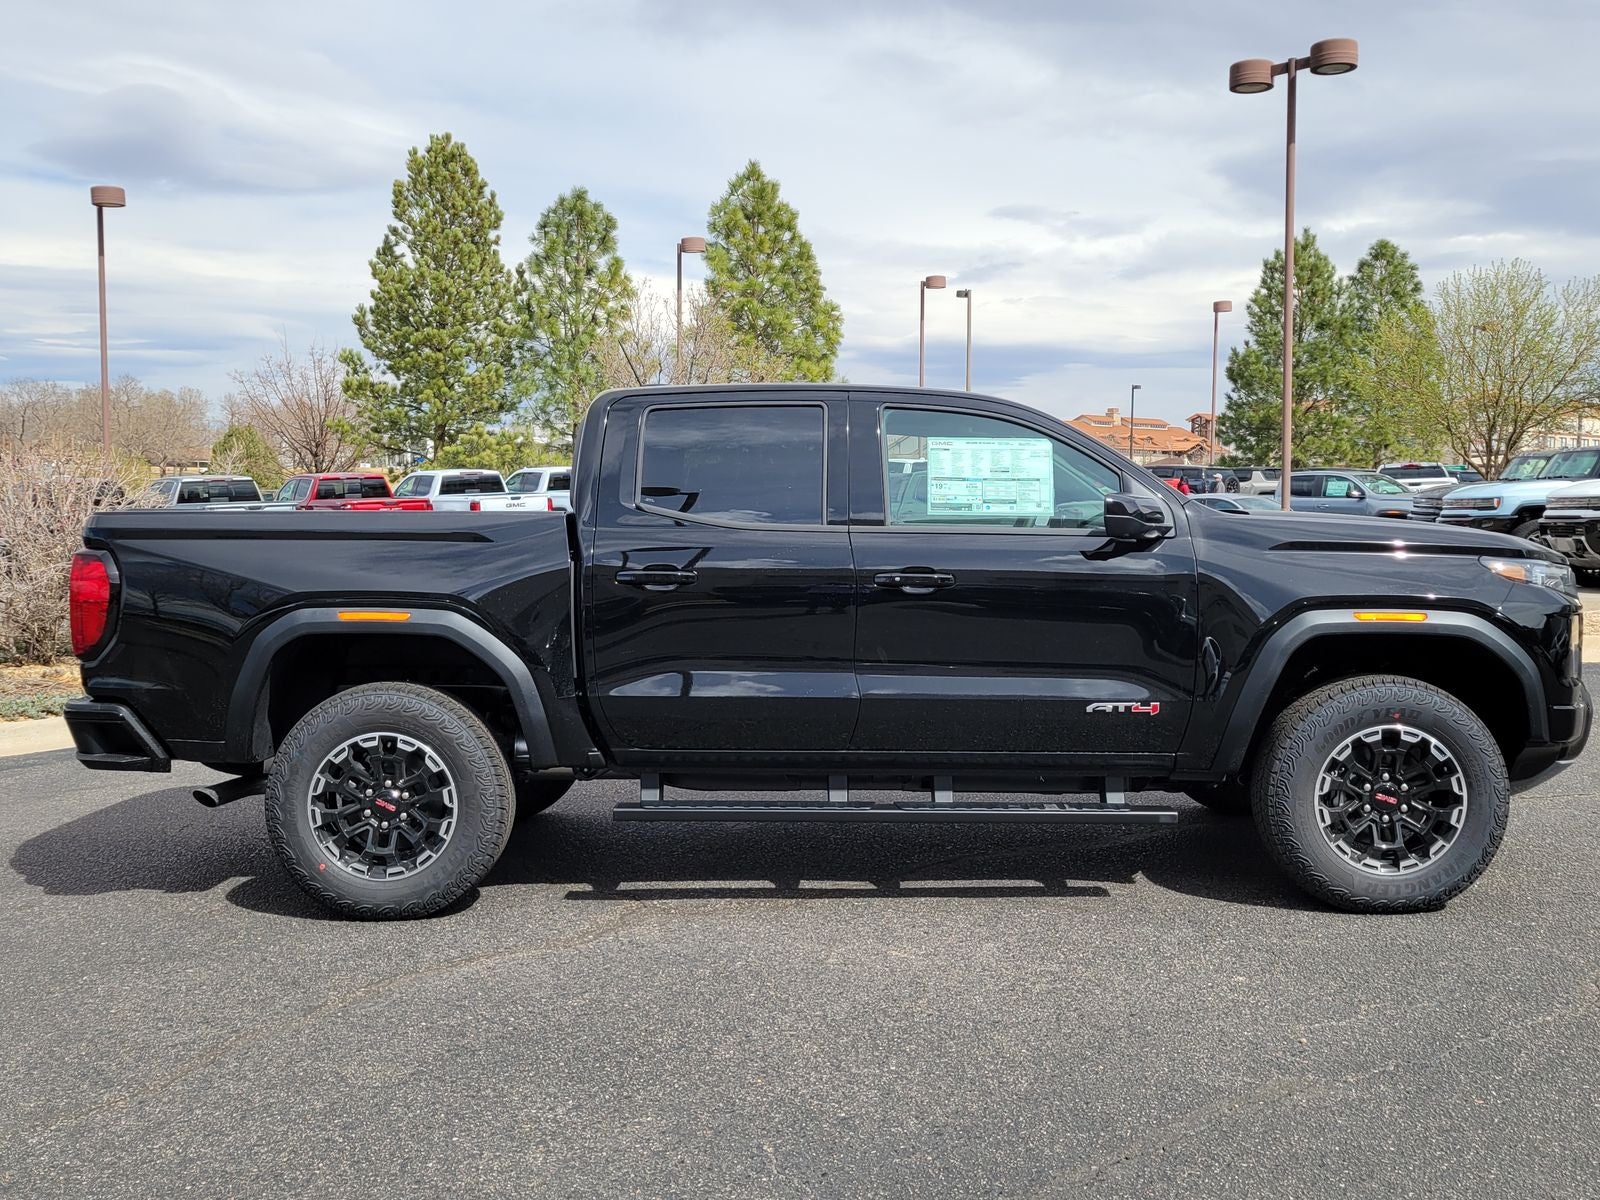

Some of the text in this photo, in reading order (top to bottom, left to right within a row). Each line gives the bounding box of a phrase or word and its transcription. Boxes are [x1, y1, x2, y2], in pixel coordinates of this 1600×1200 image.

[1086, 702, 1160, 716] AT4
[375, 798, 397, 812] GMC
[1375, 792, 1398, 805] GMC
